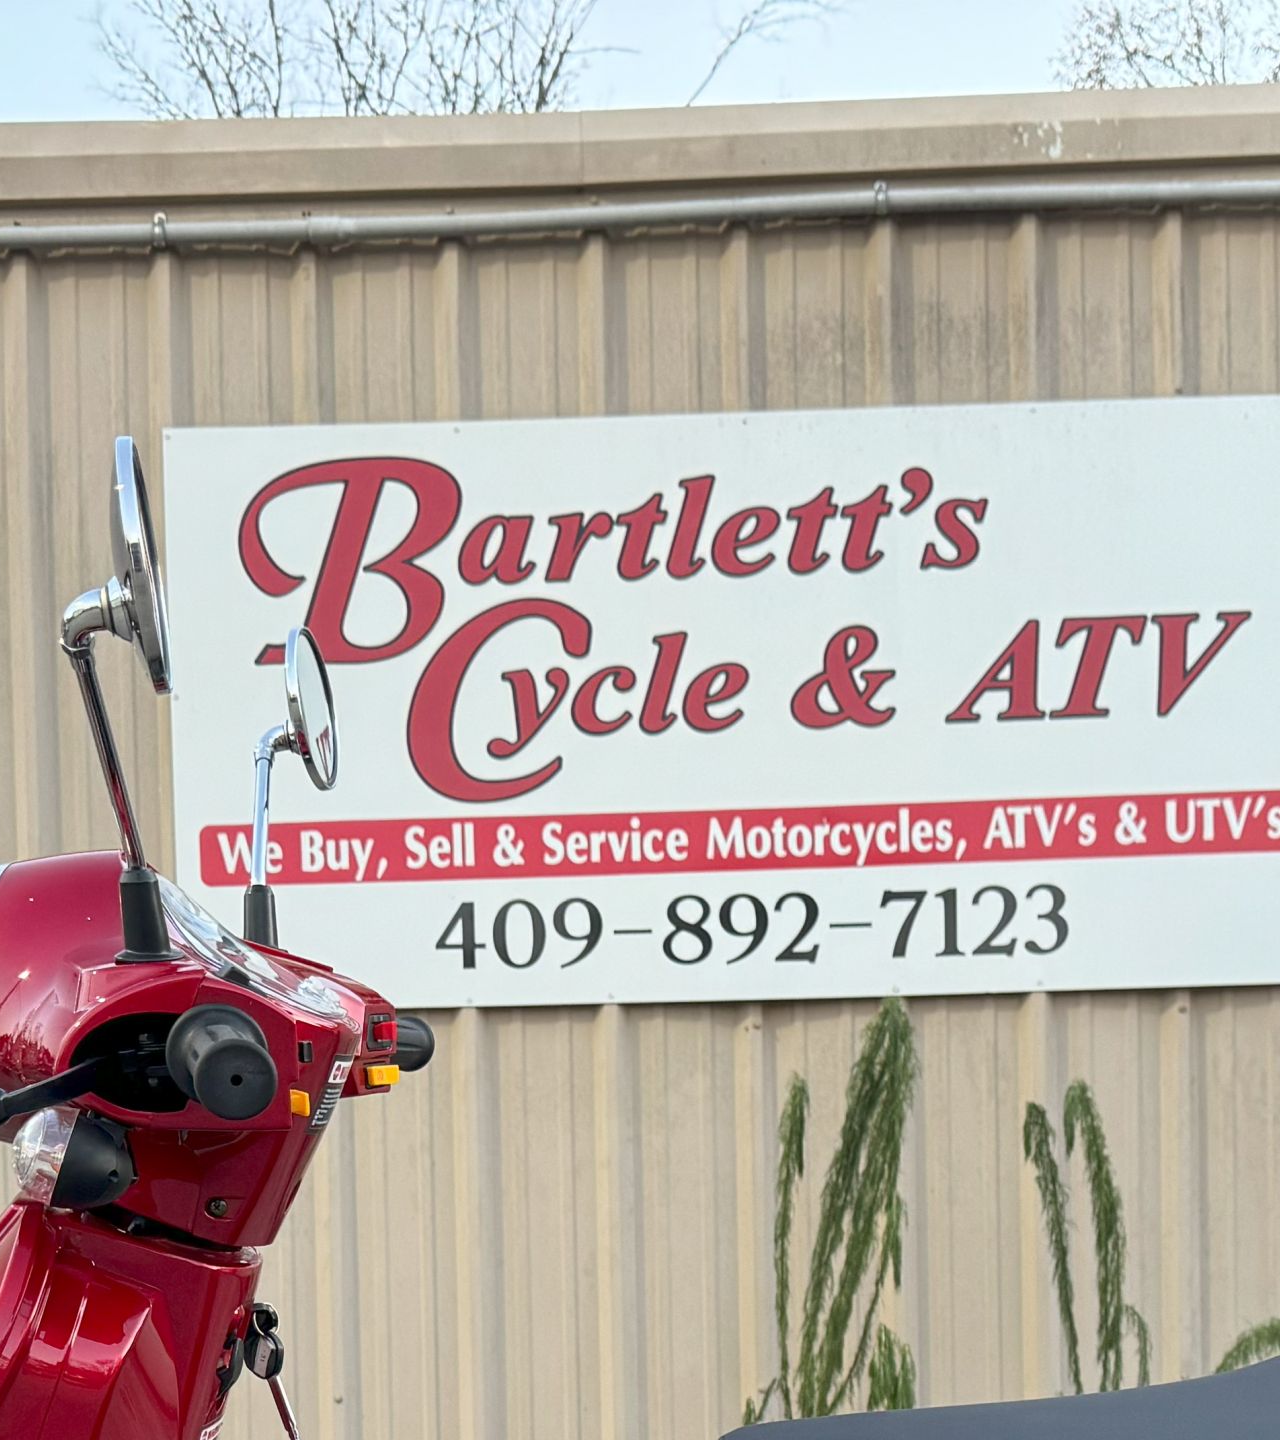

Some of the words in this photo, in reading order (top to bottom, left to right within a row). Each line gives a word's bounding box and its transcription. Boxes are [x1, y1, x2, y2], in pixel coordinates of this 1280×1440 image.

[238, 456, 988, 665] Bartlett's
[407, 598, 749, 802] Cycle
[791, 625, 896, 729] &
[945, 611, 1251, 723] ATV
[217, 832, 283, 874] We
[300, 829, 388, 883] Buy,
[404, 822, 476, 870] Sell
[493, 823, 525, 867] &
[542, 816, 689, 866] Service
[706, 807, 968, 867] Motorcycles,
[983, 803, 1097, 849] ATV's
[1114, 801, 1147, 846] &
[435, 883, 1069, 969] 409-892-7123
